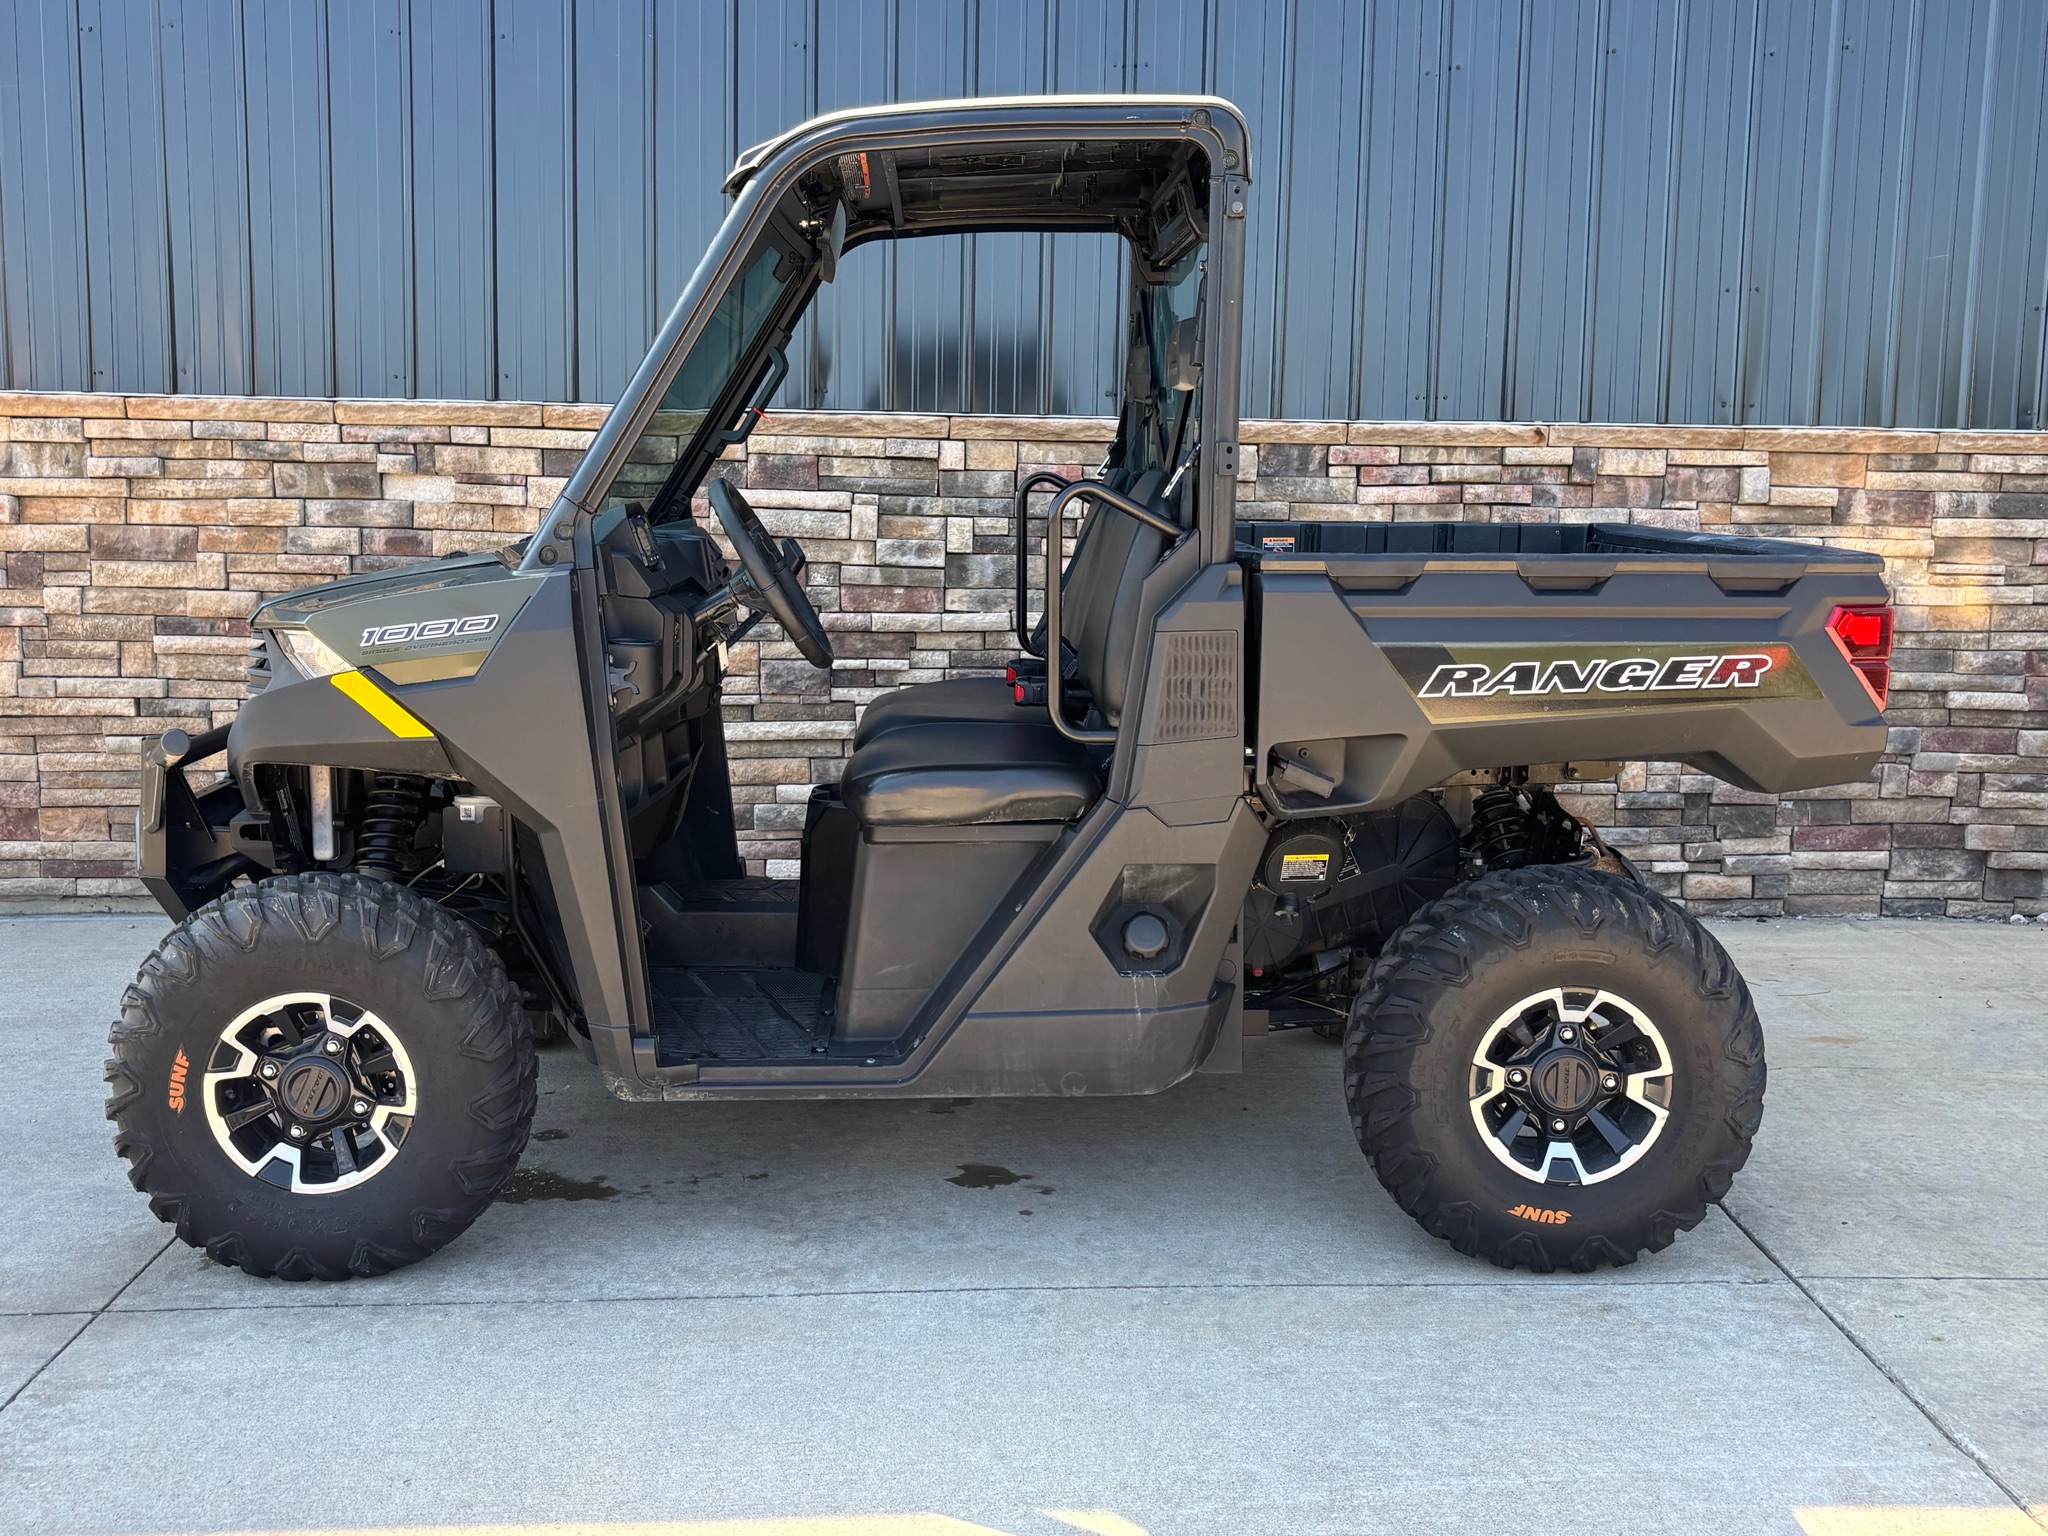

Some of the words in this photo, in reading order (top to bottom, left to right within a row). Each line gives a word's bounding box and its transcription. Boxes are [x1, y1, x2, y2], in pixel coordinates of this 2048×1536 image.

[359, 614, 499, 648] 1000
[361, 646, 401, 656] SINGLE
[404, 639, 465, 651] OVERHEAD
[467, 636, 492, 644] CAM
[1417, 653, 1774, 699] RANGER
[168, 1044, 191, 1116] SUNF
[1506, 1203, 1573, 1226] SUNF
